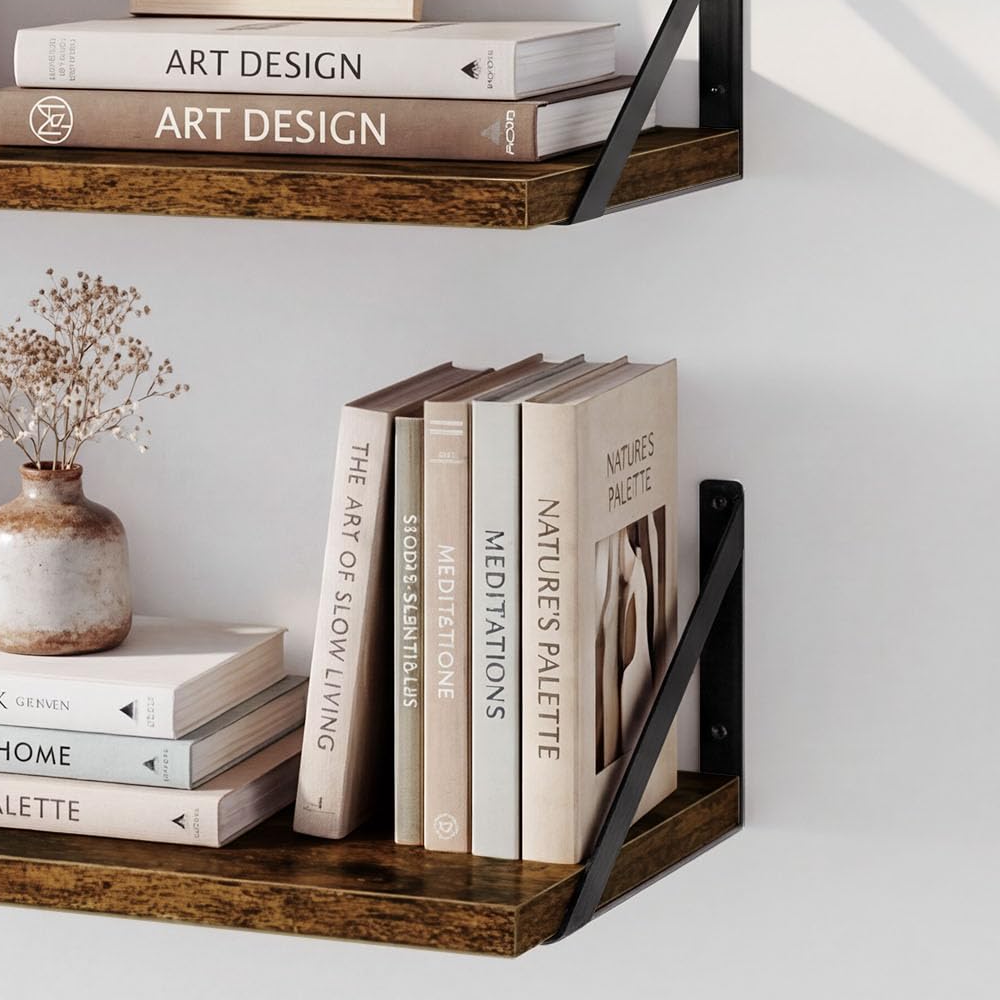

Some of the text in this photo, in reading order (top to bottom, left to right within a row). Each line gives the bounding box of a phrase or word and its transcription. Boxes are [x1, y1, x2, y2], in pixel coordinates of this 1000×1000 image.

[166, 50, 362, 80] ART DESIGN
[155, 107, 386, 145] ART DESIGN
[348, 443, 370, 484] THE
[605, 467, 652, 512] PALETTE
[337, 552, 357, 582] OF
[328, 592, 352, 662] SLOW
[485, 530, 505, 719] MEDITATIONS
[536, 498, 561, 760] NATURE'S PALETTE
[316, 668, 345, 752] LIVING
